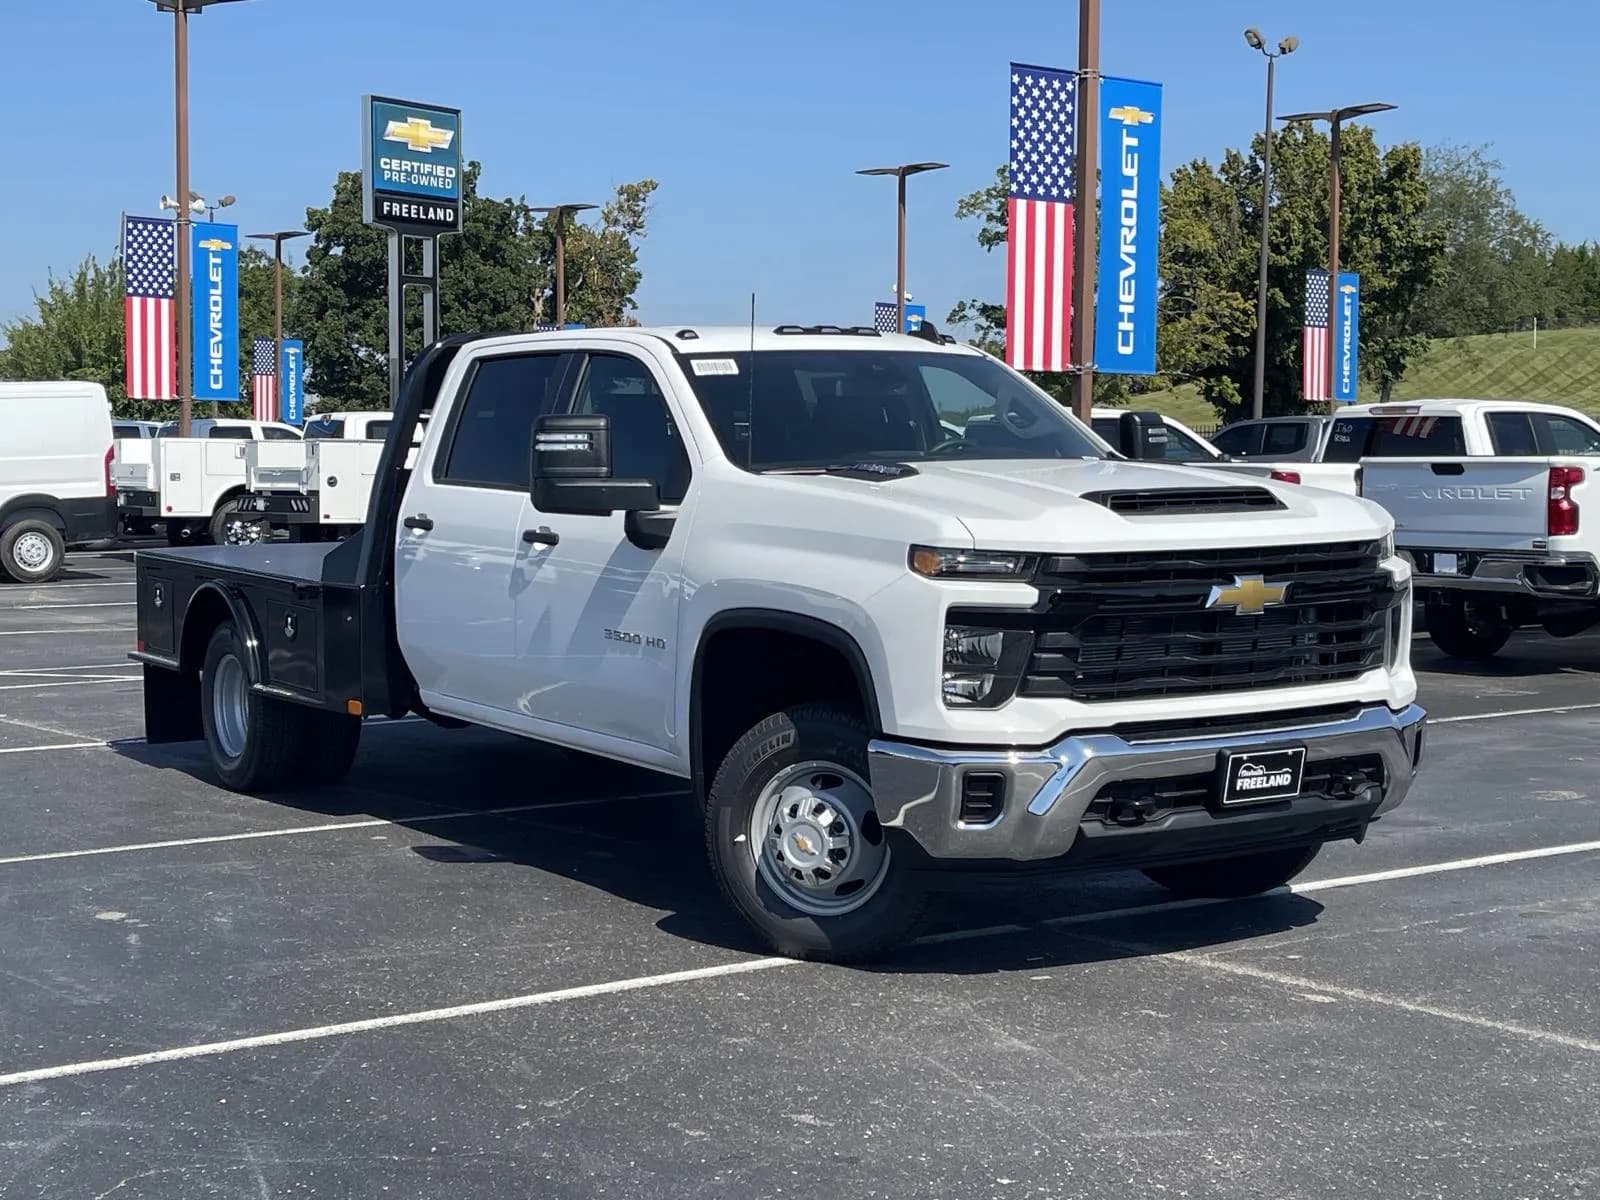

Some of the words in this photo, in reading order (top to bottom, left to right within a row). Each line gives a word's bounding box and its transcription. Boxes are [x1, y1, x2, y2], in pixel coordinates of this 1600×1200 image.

[380, 157, 456, 178] CERTIFIED
[383, 170, 452, 189] PRE-OWNED
[383, 201, 454, 222] FREELAND
[1117, 129, 1139, 355] CHEVROLET
[209, 252, 224, 390] CHEVROLET
[1342, 295, 1352, 393] CHEVROLET
[289, 353, 297, 420] CHEVROLET
[646, 636, 666, 649] HD
[1236, 774, 1291, 791] FREELAND
